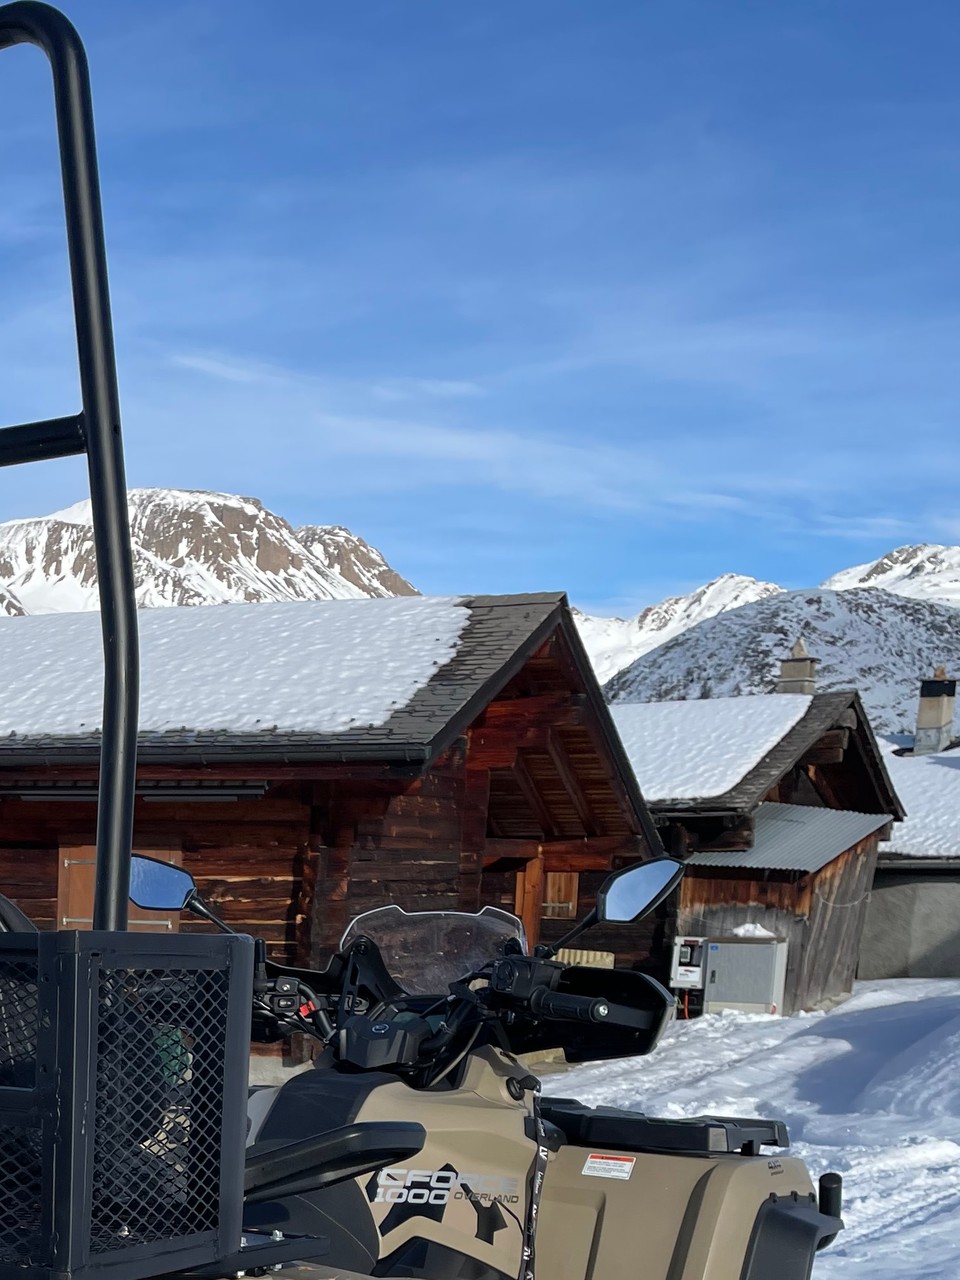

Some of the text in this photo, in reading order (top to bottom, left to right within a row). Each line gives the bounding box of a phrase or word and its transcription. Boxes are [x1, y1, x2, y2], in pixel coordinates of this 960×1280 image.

[377, 1168, 519, 1192] CFORCE
[374, 1187, 520, 1205] 1000 OVERLAND
